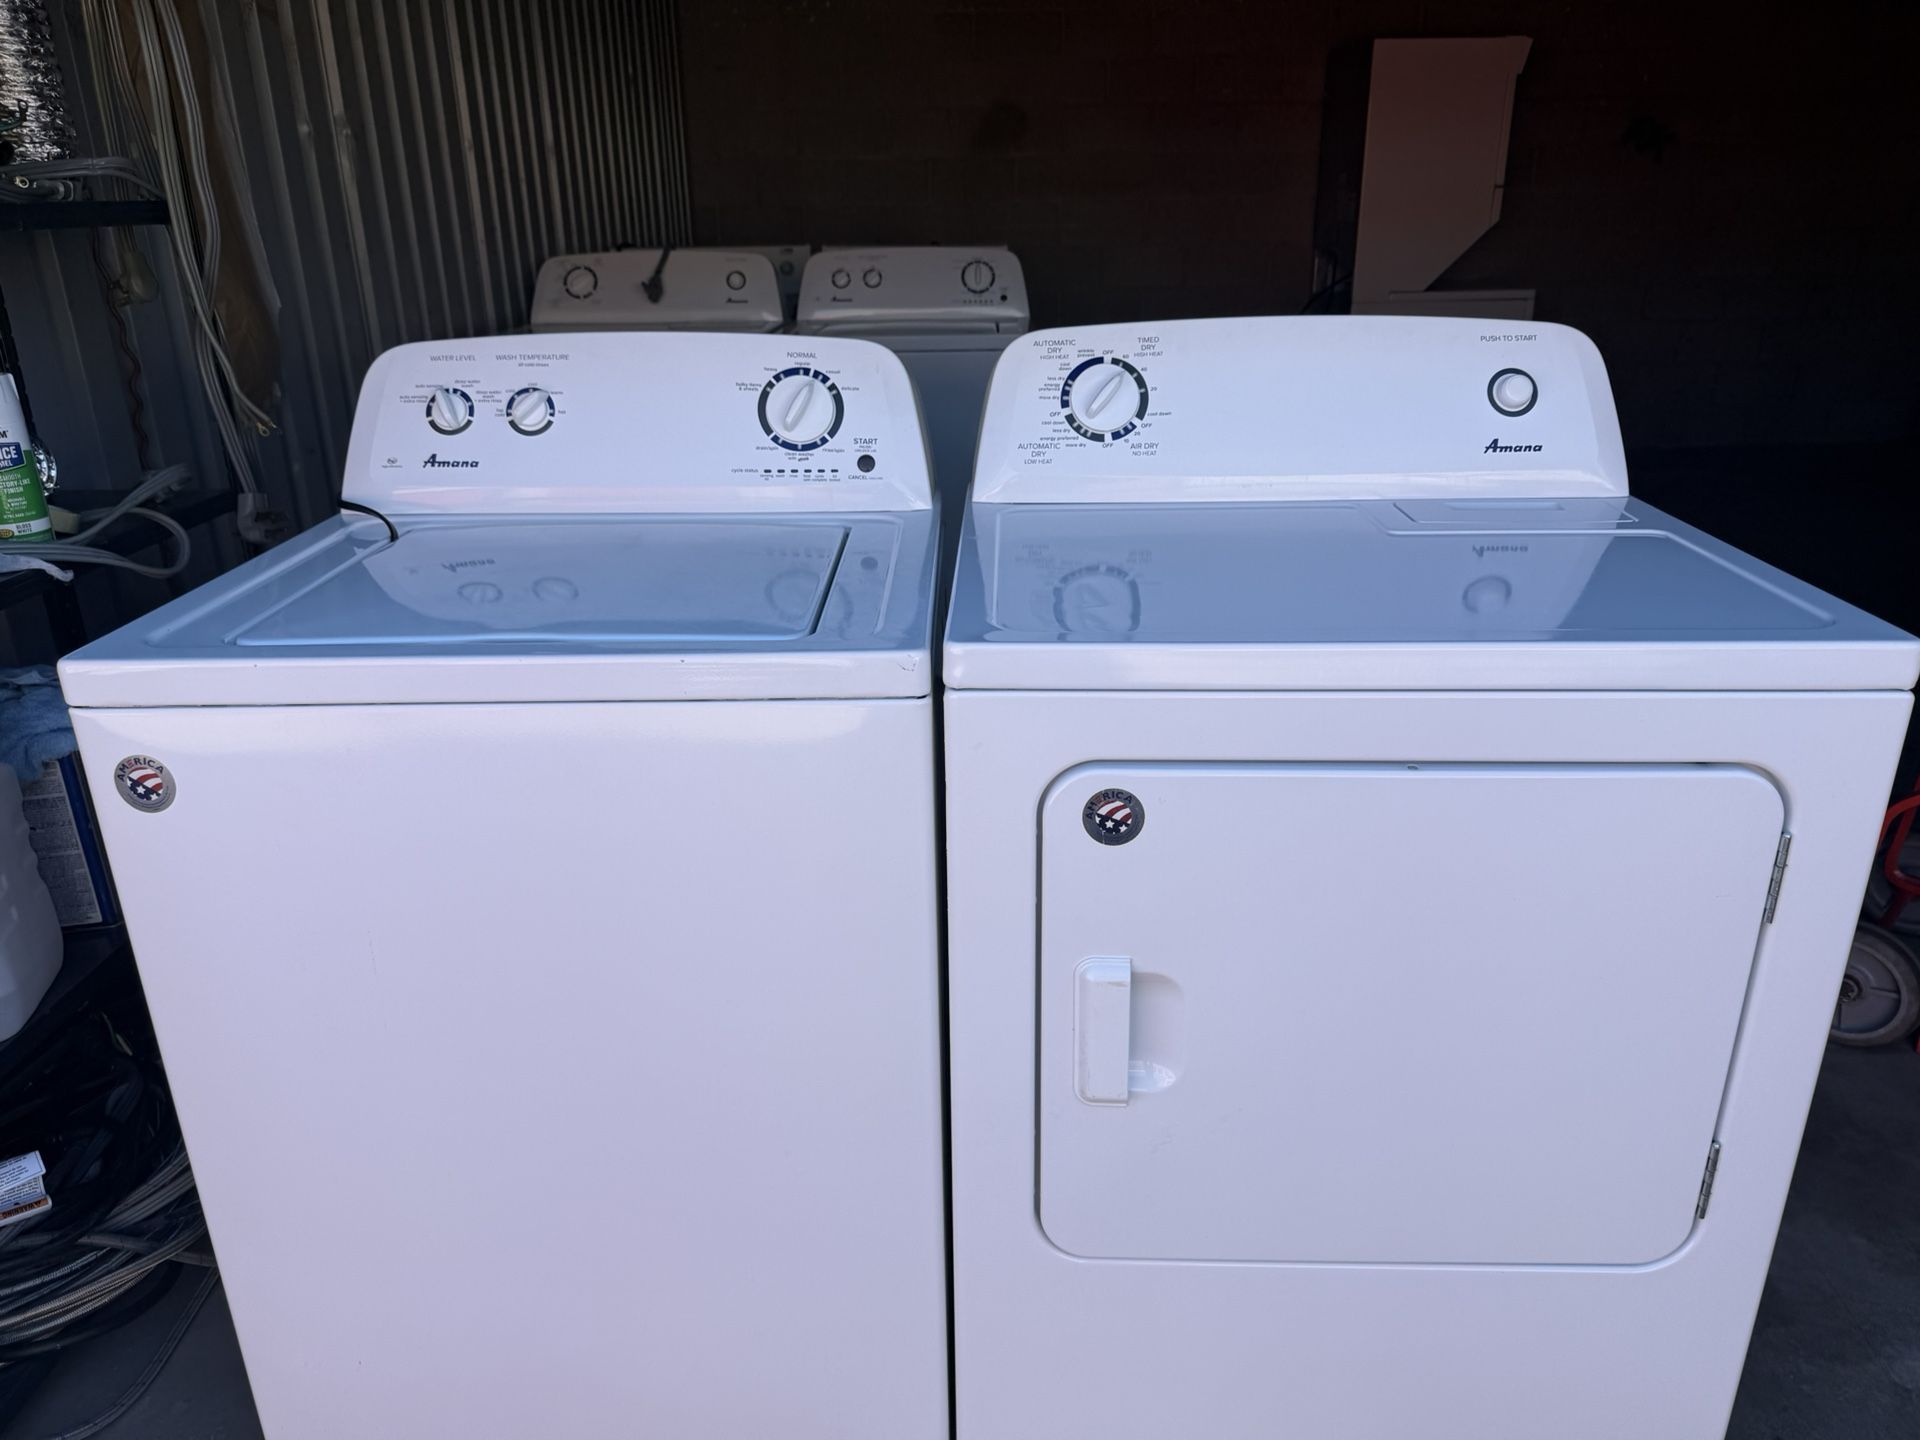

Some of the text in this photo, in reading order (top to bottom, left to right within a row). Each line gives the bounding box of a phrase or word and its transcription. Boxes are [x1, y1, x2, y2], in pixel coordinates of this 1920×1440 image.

[1033, 339, 1076, 347] AUTOMATIC
[1137, 336, 1160, 344] TIMED
[853, 437, 878, 445] START
[1017, 442, 1061, 450] AUTOMATIC
[1484, 438, 1543, 454] Amana
[1031, 450, 1047, 458] DRY
[422, 453, 480, 469] Amana
[117, 757, 165, 783] AMERICA
[1086, 790, 1133, 820] AMERICA
